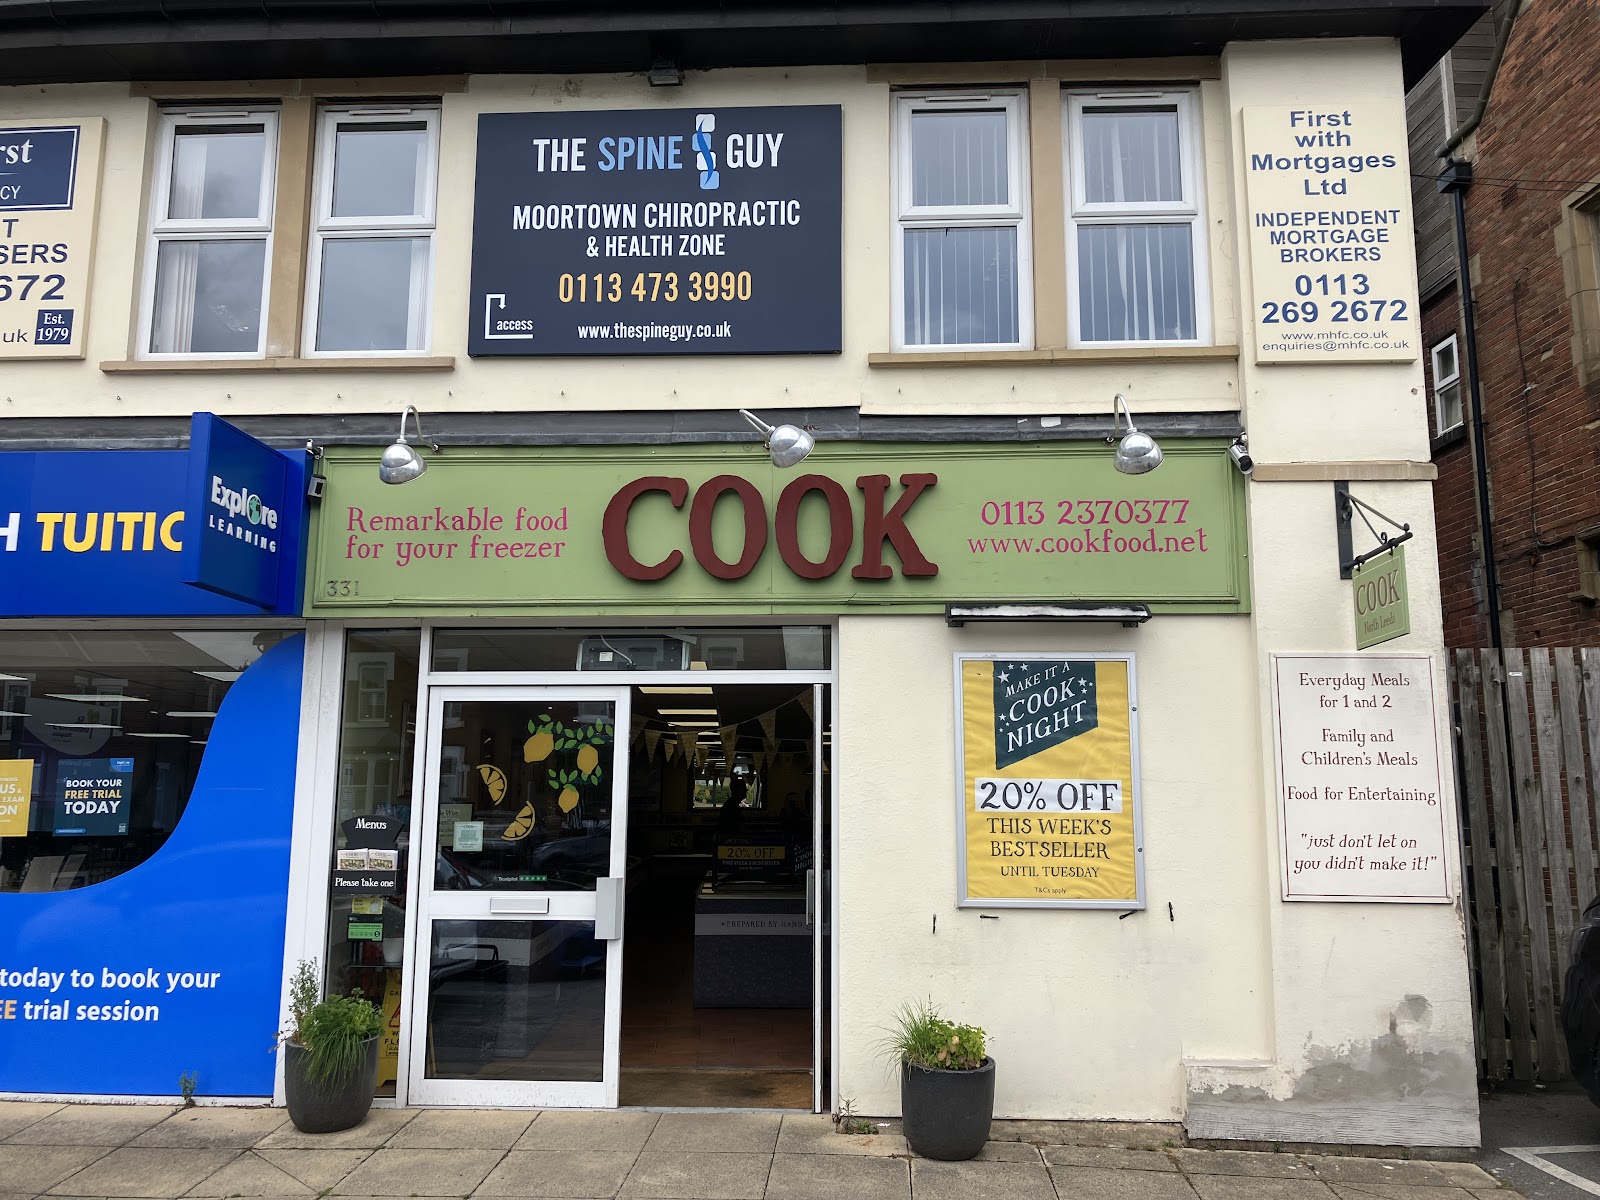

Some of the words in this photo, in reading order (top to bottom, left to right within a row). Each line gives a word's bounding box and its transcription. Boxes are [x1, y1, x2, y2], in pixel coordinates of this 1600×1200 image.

[1291, 111, 1351, 127] First
[1295, 131, 1350, 147] with
[533, 138, 586, 171] THE
[597, 136, 682, 171] SPINE
[726, 133, 783, 168] GUY
[1252, 154, 1396, 173] Mortgages
[1305, 179, 1346, 195] Ltd
[513, 203, 637, 230] MOORTOWN
[645, 200, 800, 228] CHIROPRACTIC
[1256, 210, 1400, 227] INDEPENDENT
[586, 236, 599, 257] &
[606, 235, 672, 256] HEALTH
[679, 234, 725, 255] ZONE
[1271, 229, 1389, 244] MORTGAGE
[1281, 247, 1381, 262] BROKERS
[560, 273, 622, 302] 0113
[631, 272, 678, 301] 473
[688, 271, 752, 301] 3990
[1296, 274, 1369, 296] 0113
[44, 313, 65, 324] Est.
[1262, 302, 1318, 323] 269
[1331, 300, 1407, 322] 2672
[497, 320, 533, 330] access
[578, 321, 731, 341] www.thespineguy.co.uk
[37, 328, 68, 341] 1979
[1281, 330, 1389, 340] www.mhfc.co.uk
[1263, 338, 1409, 351] enquiries@mhfc.co.uk
[346, 506, 504, 531] Remarkable
[515, 507, 567, 530] food
[982, 501, 1044, 525] 0113
[1058, 500, 1189, 524] 2370377
[209, 514, 277, 553] LEARNING
[602, 474, 938, 582] COOK
[968, 524, 1208, 553] www.cookfood.net
[346, 535, 383, 558] for
[396, 541, 458, 567] your
[470, 534, 565, 558] freezer
[326, 580, 360, 597] 331
[1356, 569, 1401, 616] COOK
[1364, 616, 1379, 634] North
[1380, 611, 1396, 629] Leeds
[1004, 674, 1041, 698] MAKE
[1045, 666, 1058, 681] IT
[1061, 661, 1071, 673] A
[1300, 673, 1365, 690] Everyday
[1372, 673, 1409, 685] Meals
[1008, 676, 1076, 723] COOK
[1320, 695, 1338, 707] for
[1343, 695, 1349, 707] 1
[1354, 696, 1377, 707] and
[1383, 695, 1392, 707] 2
[1007, 699, 1088, 753] NIGHT
[1323, 729, 1365, 747] Family
[1370, 729, 1394, 742] and
[1302, 752, 1371, 765] Children's
[1377, 752, 1417, 765] Meals
[66, 779, 94, 788] BOOK
[96, 779, 122, 787] YOUR
[65, 790, 89, 799] FREE
[92, 789, 122, 799] TRIAL
[980, 782, 1046, 810] 20%
[1057, 783, 1118, 811] OFF
[1288, 786, 1318, 799] Food
[1325, 787, 1343, 800] for
[1348, 787, 1436, 805] Entertaining
[64, 801, 121, 815] TODAY
[355, 817, 387, 830] Menus
[987, 817, 1032, 835] THIS
[1039, 818, 1112, 836] WEEK'S
[990, 840, 1110, 859] BESTSELLER
[1302, 834, 1335, 847] "just
[1339, 834, 1373, 847] don't
[1378, 834, 1397, 847] let
[1401, 840, 1416, 848] on
[727, 848, 750, 858] 20%
[754, 847, 776, 858] OFF
[1000, 866, 1039, 877] UNTIL
[1042, 866, 1100, 878] TUESDAY
[1294, 861, 1321, 874] you
[1325, 856, 1364, 869] didn't
[1370, 857, 1406, 870] make
[1412, 856, 1436, 870] it!"
[335, 877, 360, 887] Please
[361, 877, 379, 887] take
[380, 879, 394, 887] one
[726, 920, 766, 928] PREPARED
[769, 920, 778, 928] BY
[0, 966, 65, 993] today
[70, 968, 95, 988] to
[101, 967, 160, 989] book
[166, 972, 221, 994] your
[23, 998, 70, 1021] trial
[75, 999, 160, 1022] session
